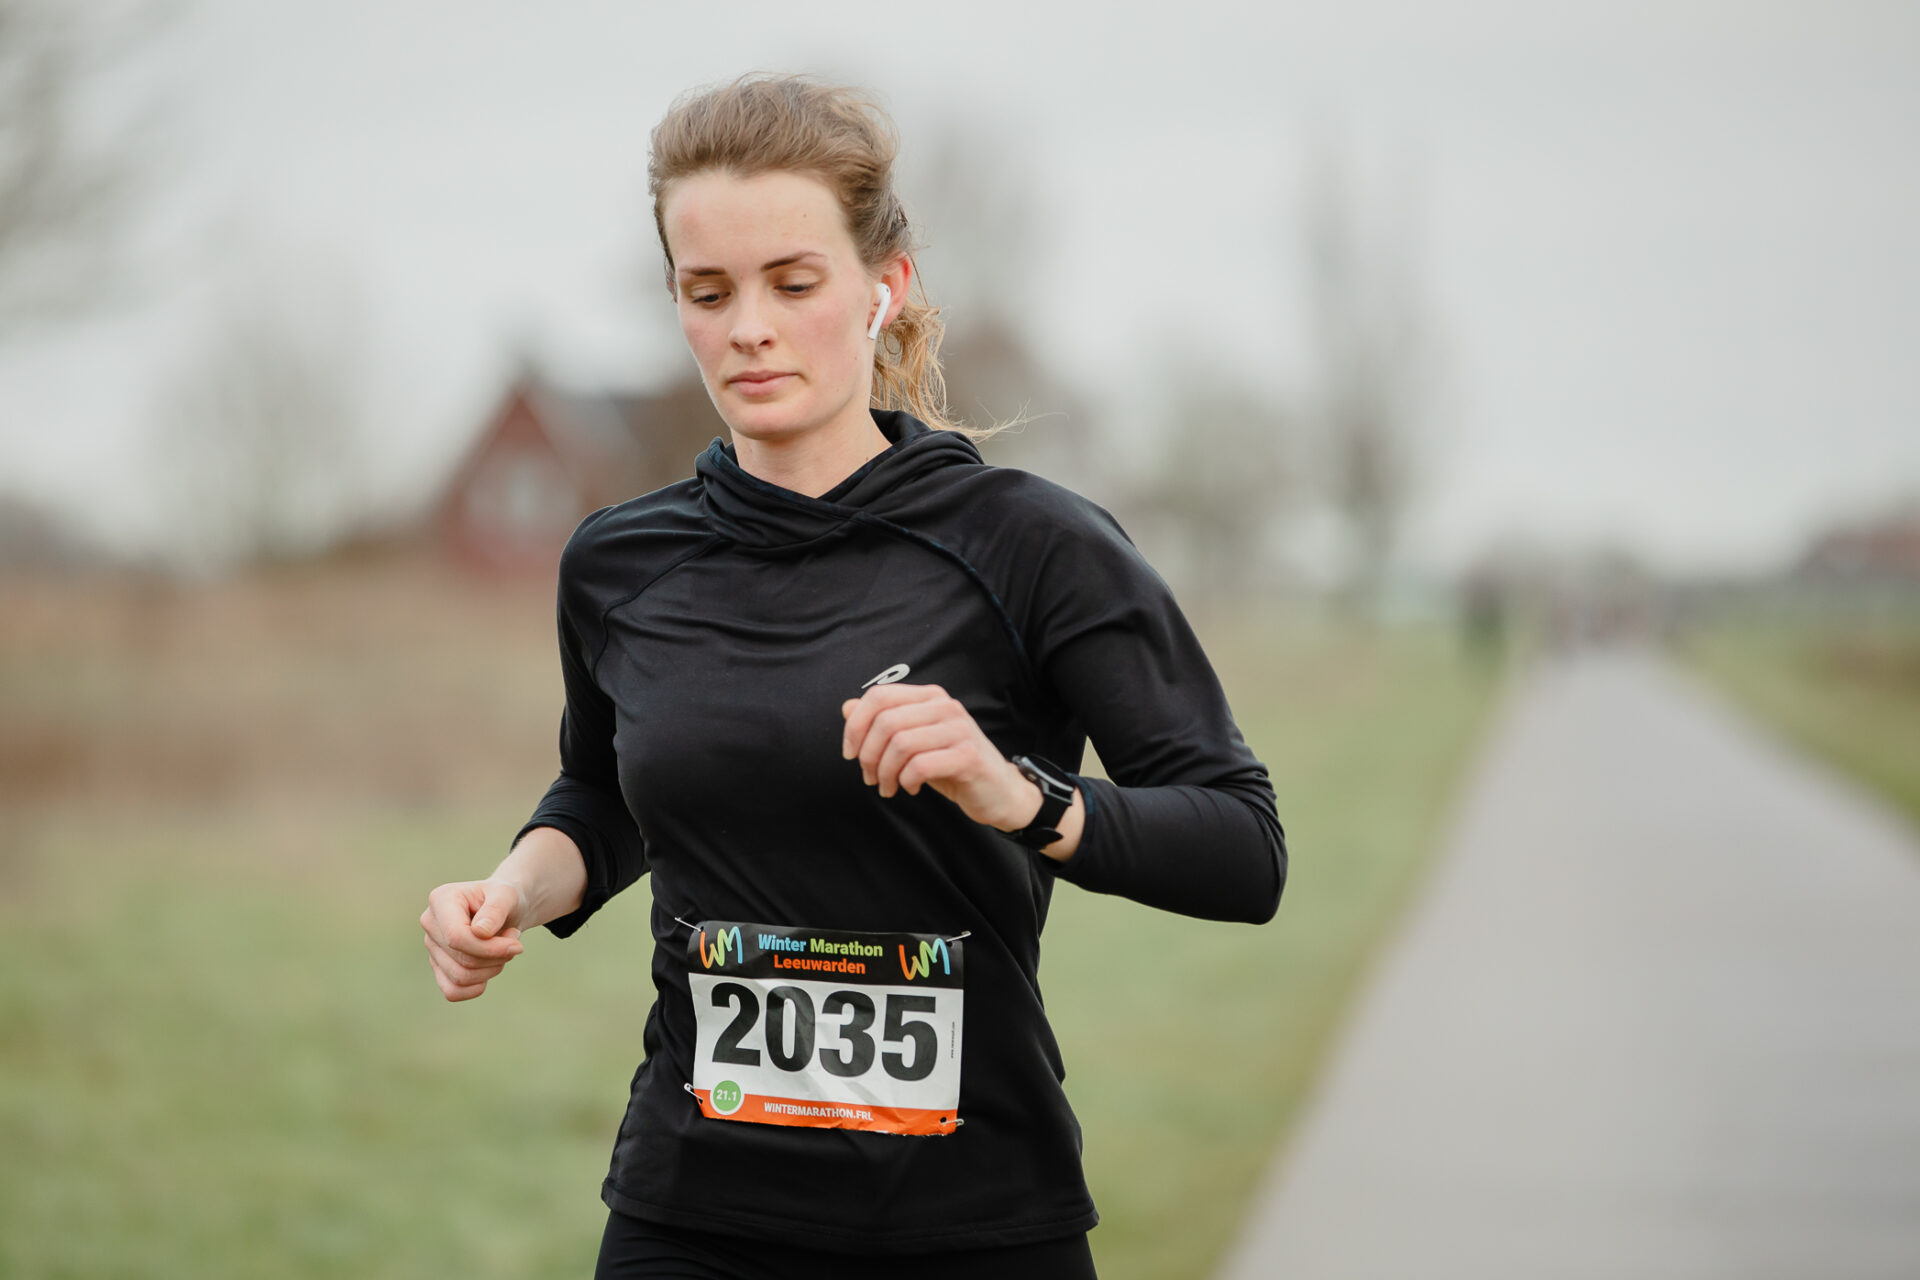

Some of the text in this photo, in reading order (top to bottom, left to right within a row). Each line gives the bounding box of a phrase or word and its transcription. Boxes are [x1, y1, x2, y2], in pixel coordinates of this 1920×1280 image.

[758, 933, 884, 957] Winter Marathon
[774, 954, 866, 975] Leeuwarden
[711, 982, 938, 1082] 2035
[716, 1088, 737, 1102] 21.1
[764, 1102, 873, 1121] WINTERMARATHON.FRL
